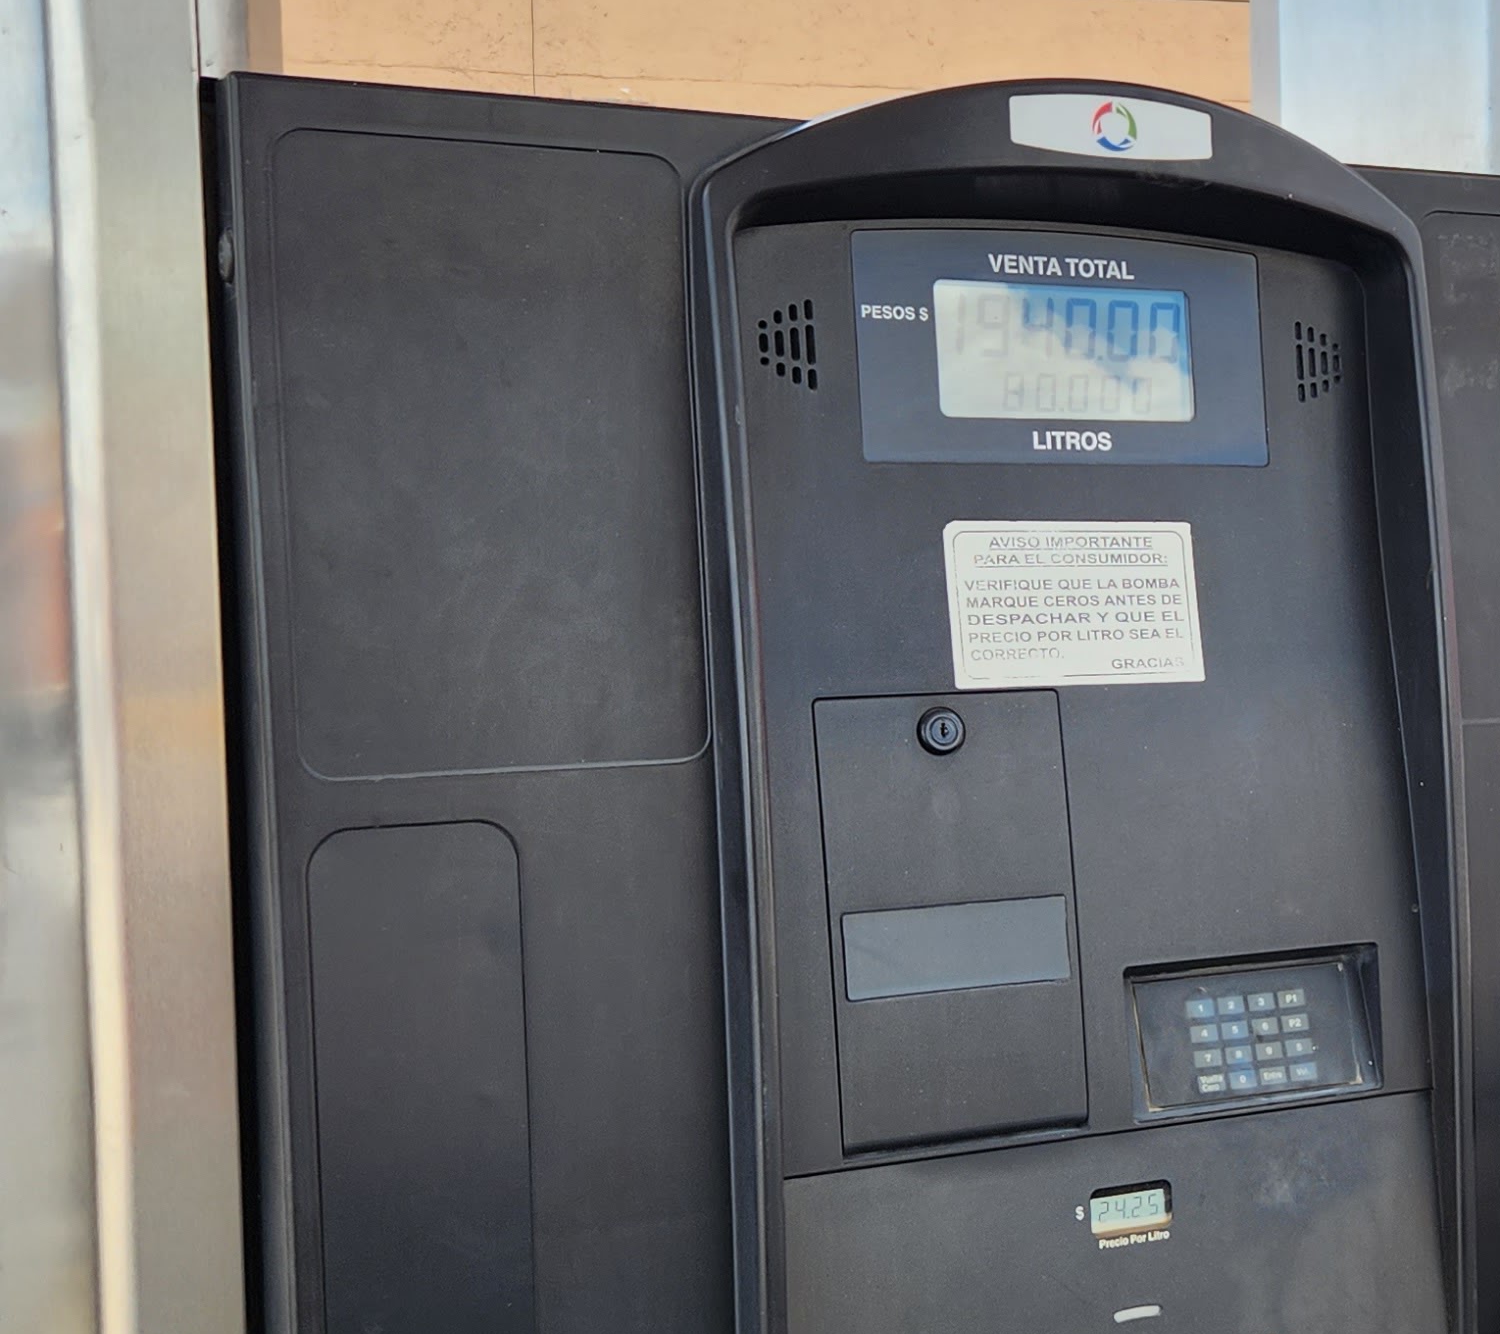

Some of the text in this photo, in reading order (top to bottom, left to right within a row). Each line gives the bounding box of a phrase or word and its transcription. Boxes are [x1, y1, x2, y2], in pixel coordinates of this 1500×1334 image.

[988, 253, 1135, 280] VENTA TOTAL
[860, 303, 929, 322] PESOS $
[1032, 430, 1113, 451] LITROS
[989, 535, 1153, 549] AVISO IMPORTANTE
[973, 553, 1168, 565] PARA EL CONSUMIDOR:
[964, 578, 1180, 591] VERIFIQUE QUE LA BOMBA
[966, 594, 1182, 609] MARQUE CEROS ANTES DE
[968, 611, 1184, 626] DESPACHAR Y QUE EL
[968, 628, 1183, 644] PRECIO POR LITRO SEA EL
[970, 648, 1065, 661] CORRECTO.
[1111, 657, 1185, 670] GRACIAS
[1227, 1000, 1235, 1010] 2
[1258, 997, 1265, 1007] 3
[1285, 994, 1298, 1004] P1
[1198, 1003, 1204, 1013] 1
[1262, 1022, 1269, 1032] 6
[1288, 1018, 1302, 1028] P2
[1201, 1028, 1209, 1038] 4
[1231, 1025, 1239, 1035] 5
[1204, 1053, 1212, 1063] 7
[1239, 1074, 1247, 1084] 0
[1075, 1205, 1084, 1221] $
[1097, 1192, 1159, 1222] 24.25
[1099, 1229, 1171, 1249] Precio Por Litro
